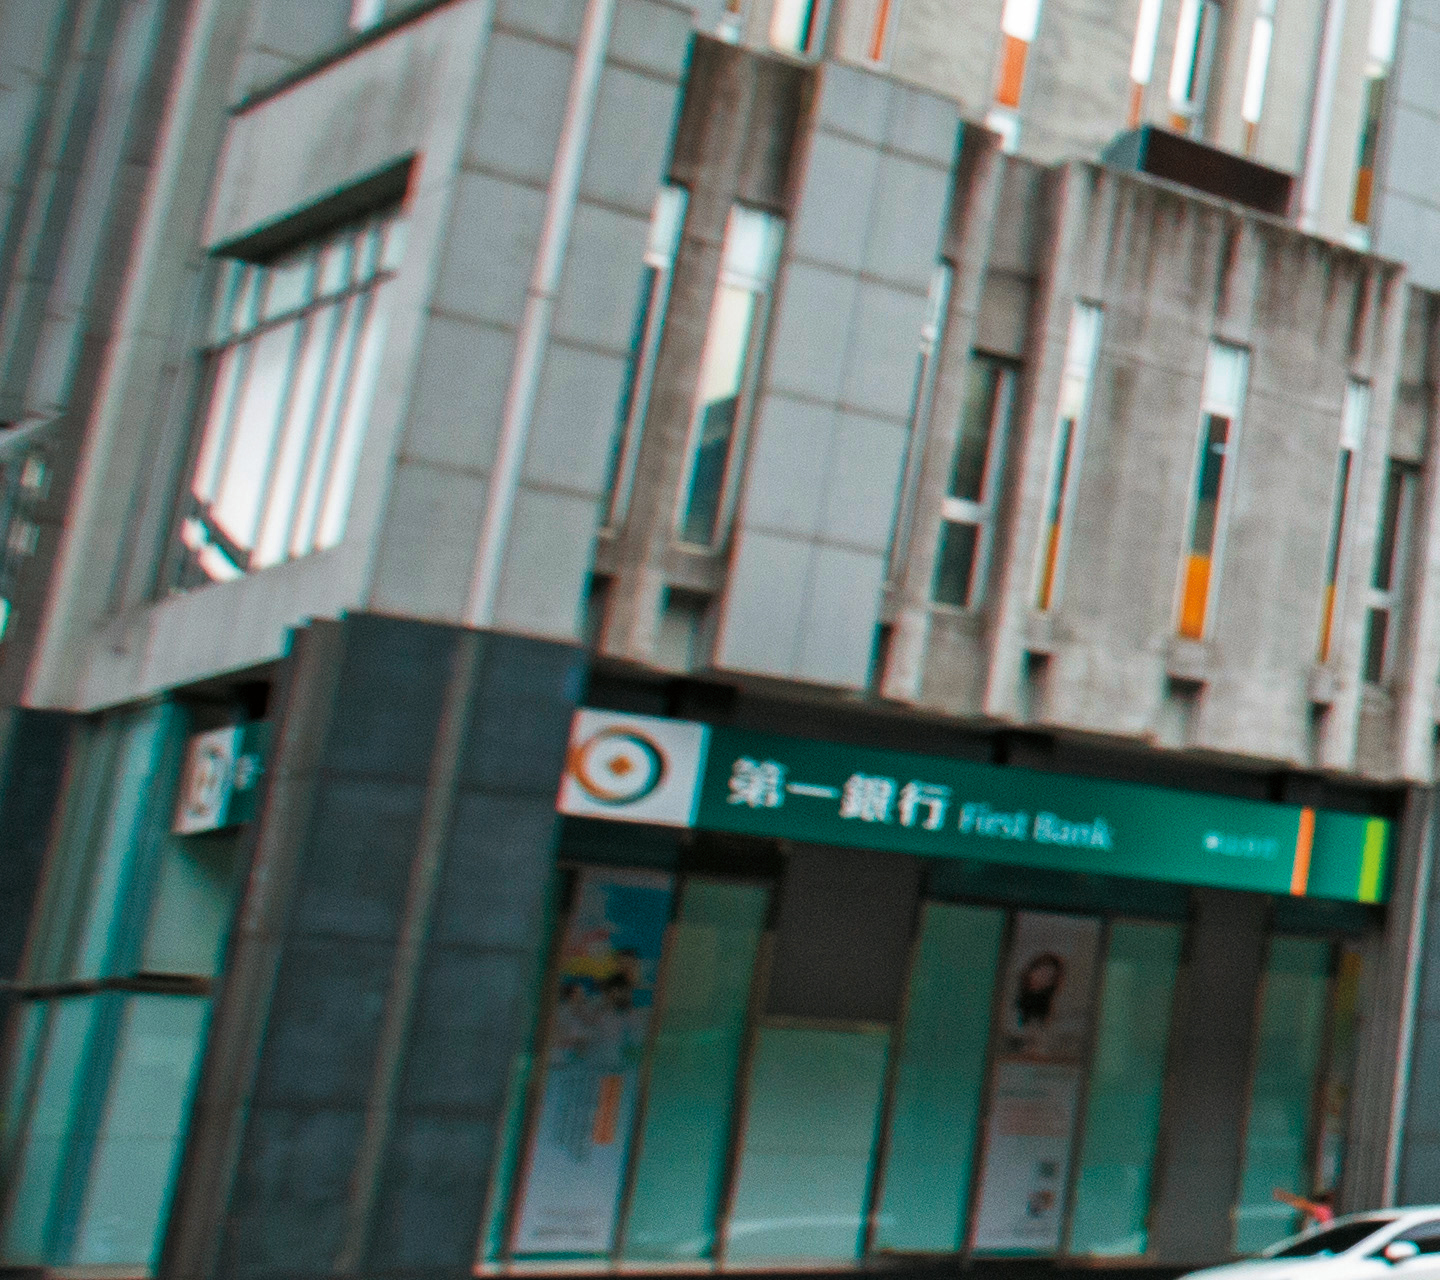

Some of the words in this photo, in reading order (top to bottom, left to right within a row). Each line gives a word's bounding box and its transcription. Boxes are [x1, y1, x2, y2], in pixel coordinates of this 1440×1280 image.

[727, 755, 952, 832] 第一銀行
[957, 801, 1027, 841] First
[1032, 811, 1113, 850] Bank
